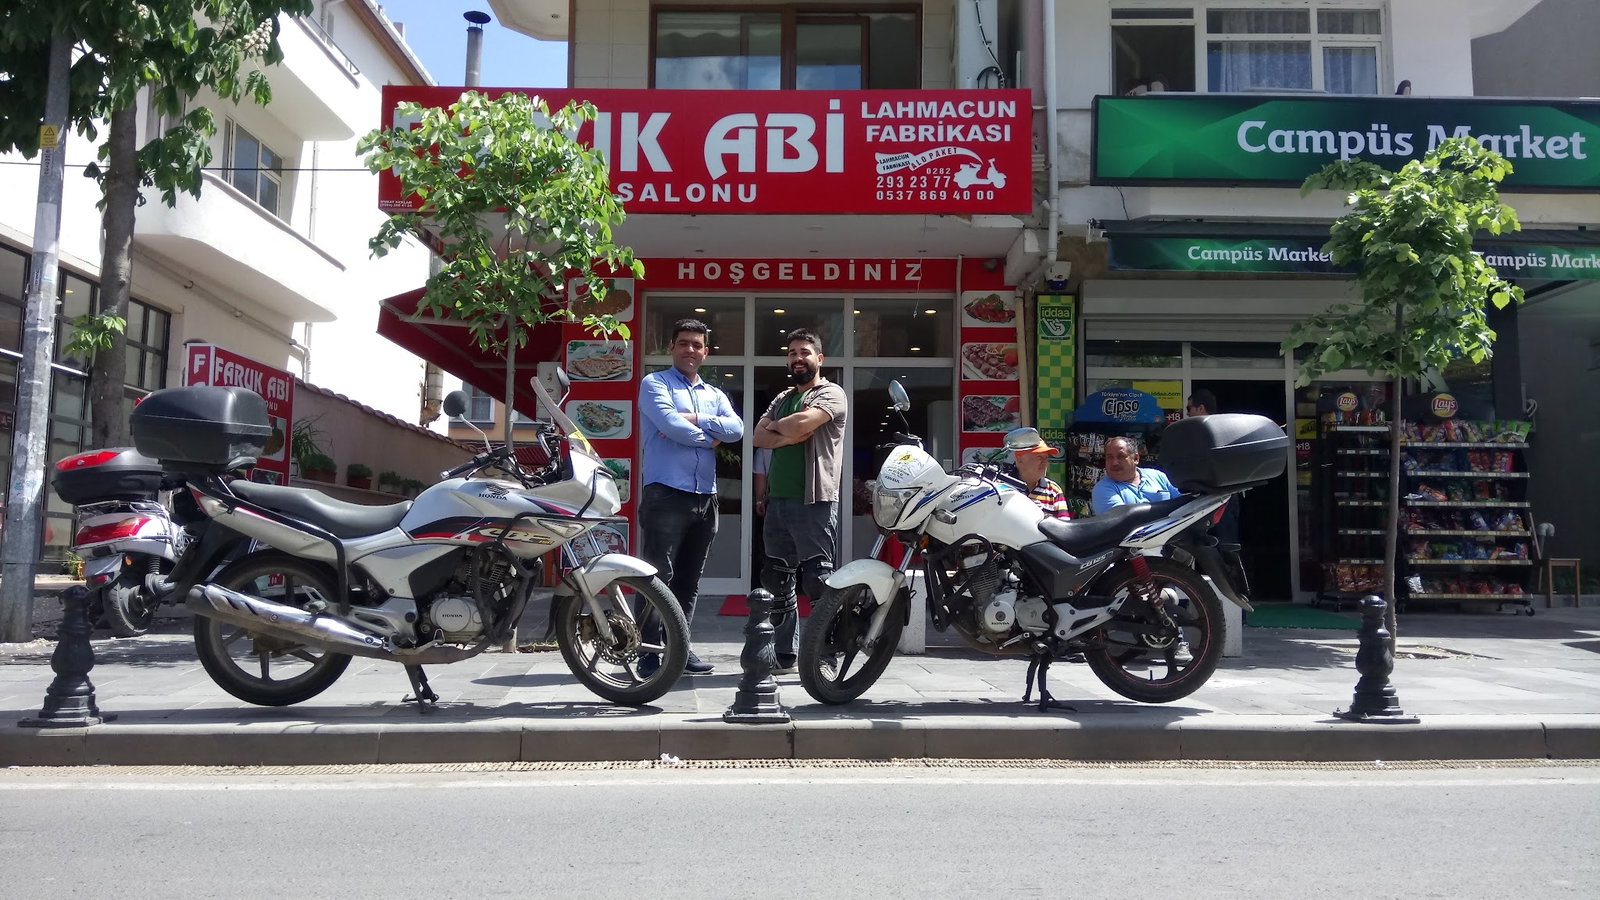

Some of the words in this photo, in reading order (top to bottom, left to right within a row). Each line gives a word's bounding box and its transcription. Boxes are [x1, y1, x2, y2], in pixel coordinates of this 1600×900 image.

[861, 100, 1016, 119] LAHMACUN
[703, 98, 845, 181] ABİ
[866, 121, 1011, 142] FABRİKASI
[1236, 120, 1414, 163] Campüs
[911, 156, 927, 170] ALO
[929, 147, 958, 160] PAKET
[926, 167, 951, 175] 0282
[876, 175, 904, 188] 293
[910, 175, 928, 188] 23
[933, 175, 951, 188] 77
[616, 181, 758, 203] SALONU
[876, 190, 913, 200] 0537
[920, 190, 947, 200] 869
[953, 190, 971, 200] 40
[977, 190, 994, 200] 00
[1187, 245, 1263, 264] Campüs
[1469, 251, 1547, 270] ampüs
[677, 259, 922, 285] HOŞGELDİNİZ
[1041, 307, 1070, 318] iddaa
[215, 356, 264, 394] FARUK
[267, 375, 290, 402] ABİ
[1102, 398, 1141, 419] Cipso
[1166, 411, 1181, 421] +18
[1041, 429, 1066, 439] idda
[1296, 442, 1311, 451] +18
[478, 493, 508, 501] HONDA
